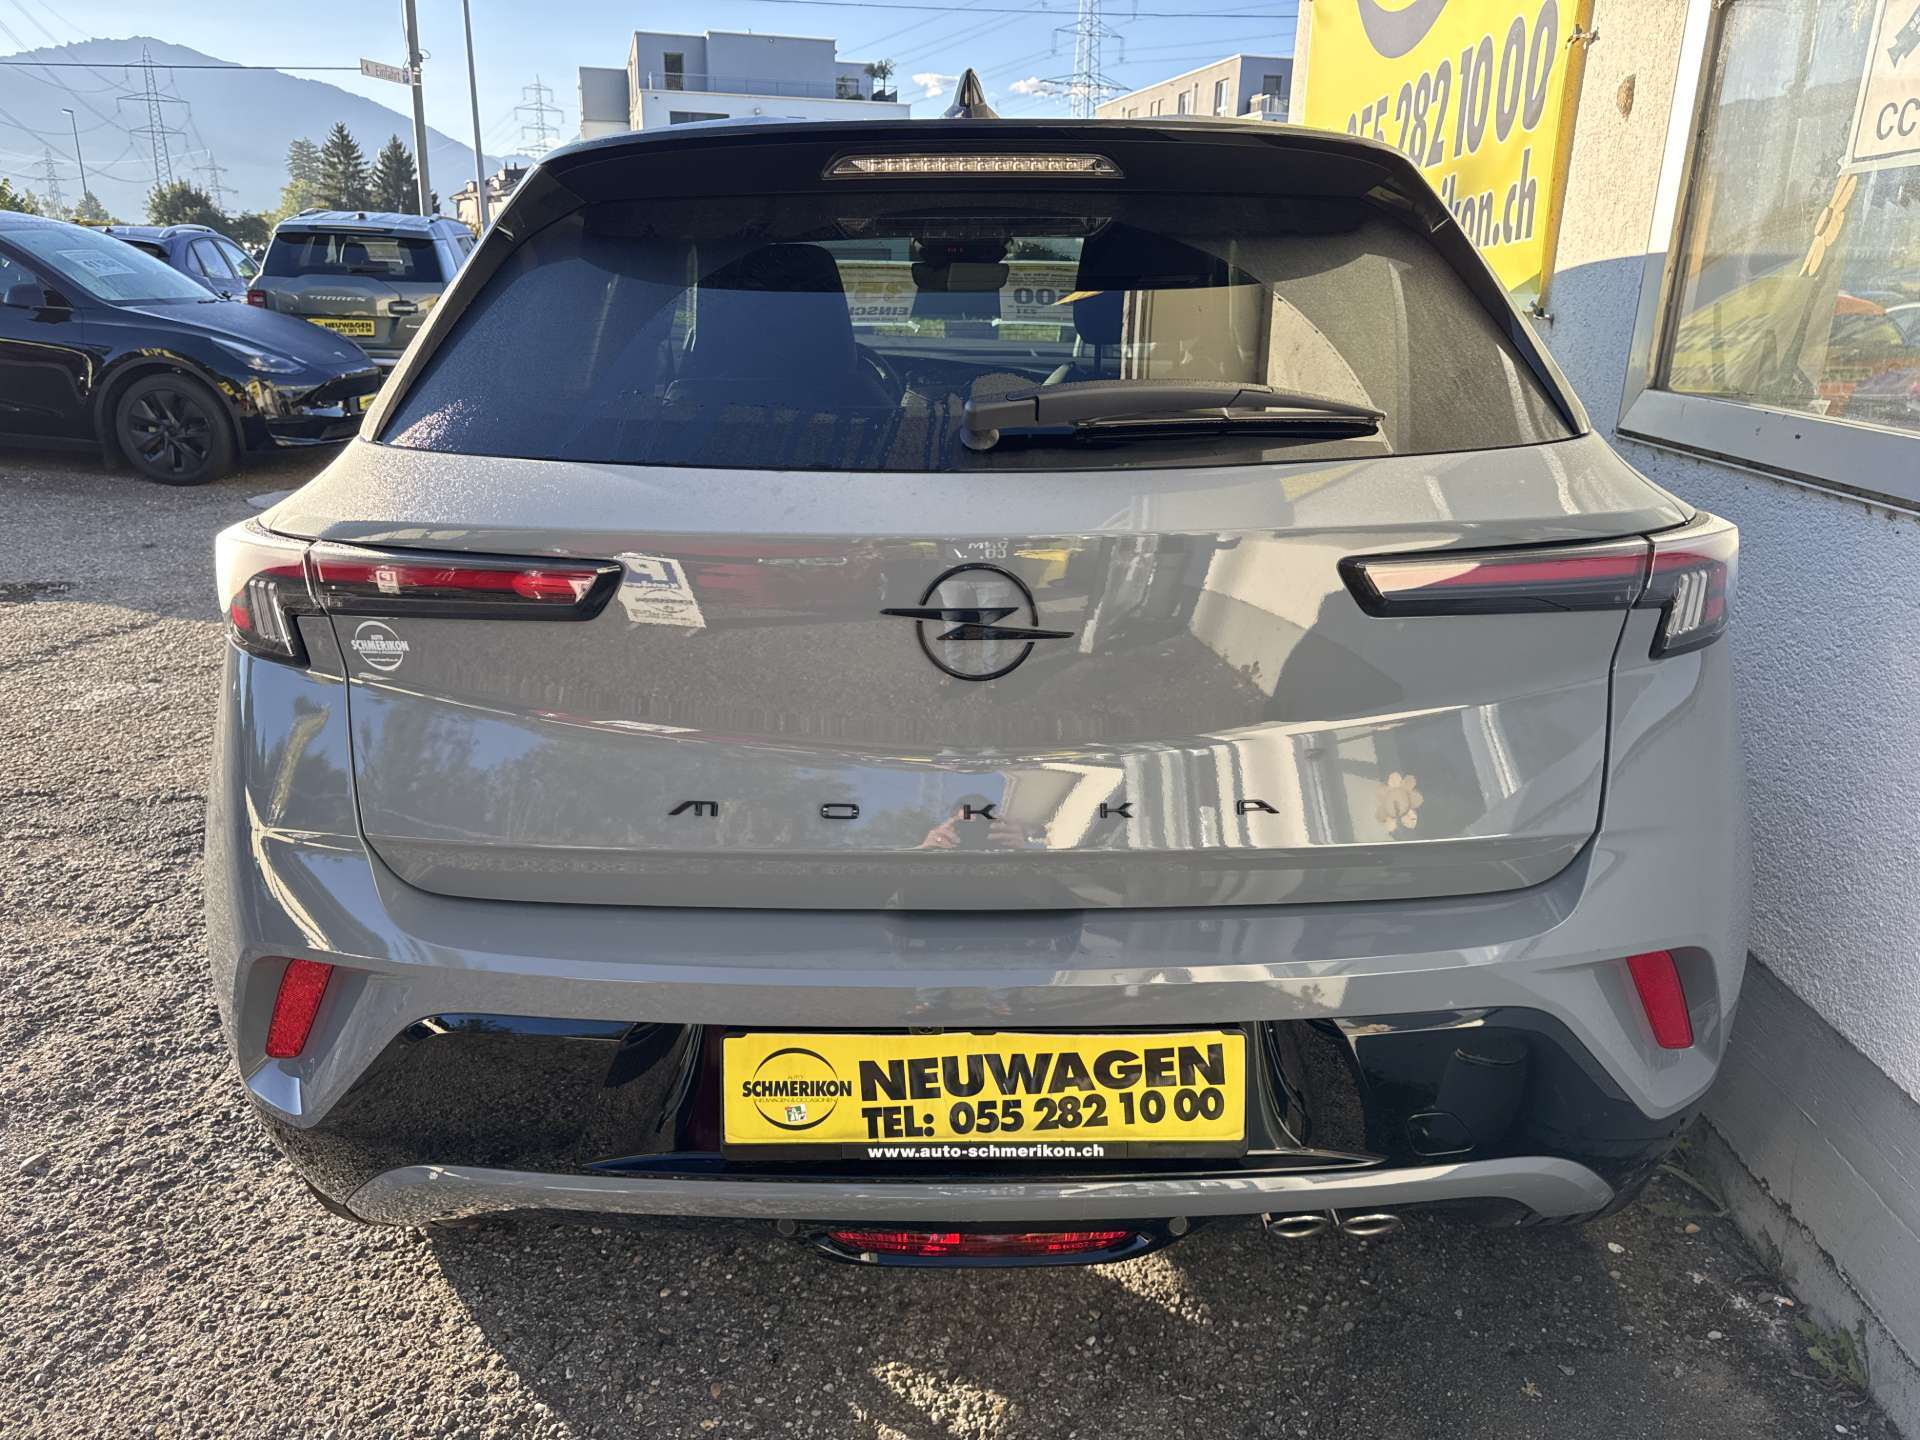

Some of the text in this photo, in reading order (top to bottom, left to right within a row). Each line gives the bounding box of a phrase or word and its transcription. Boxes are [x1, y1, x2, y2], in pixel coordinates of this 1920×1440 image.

[1395, 59, 1452, 169] 282
[1453, 35, 1494, 158] 10
[1495, 0, 1559, 143] 00
[324, 321, 372, 329] NEUWAGEN
[351, 639, 410, 652] SCHMERIKON
[668, 800, 1280, 820] MOKKA
[859, 1043, 1225, 1102] NEUWAGEN
[742, 1080, 852, 1097] SCHMERIKON
[862, 1087, 1225, 1139] TEL: 055 282 10 00
[868, 1143, 1105, 1158] www.auto-schmerikon.ch
